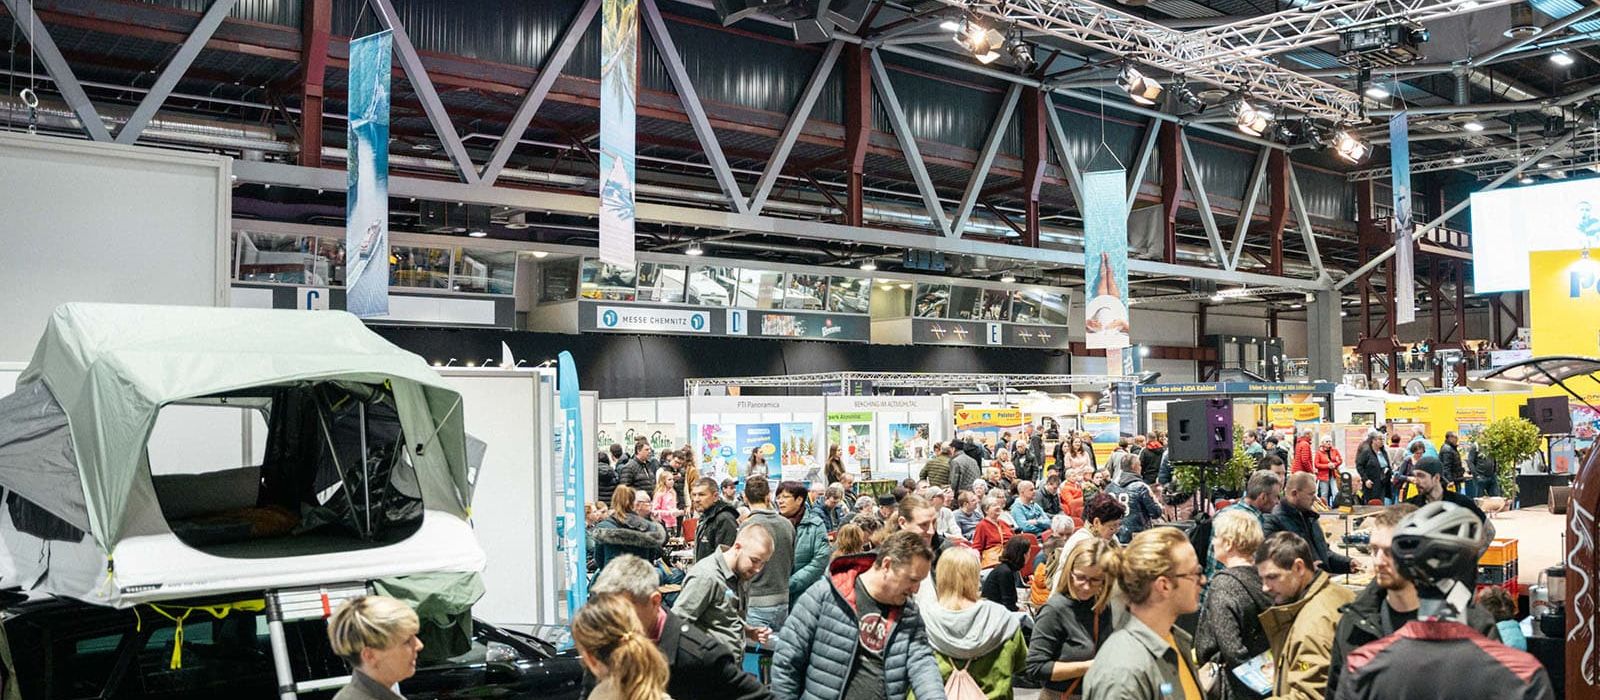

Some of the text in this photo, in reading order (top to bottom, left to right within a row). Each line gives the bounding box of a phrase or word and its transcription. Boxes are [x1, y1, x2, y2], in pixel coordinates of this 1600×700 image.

[307, 290, 320, 309] C
[622, 316, 688, 326] MESSE CHEMNITZ
[732, 311, 741, 333] D
[991, 325, 998, 343] E
[737, 401, 780, 409] PTI Panoramica
